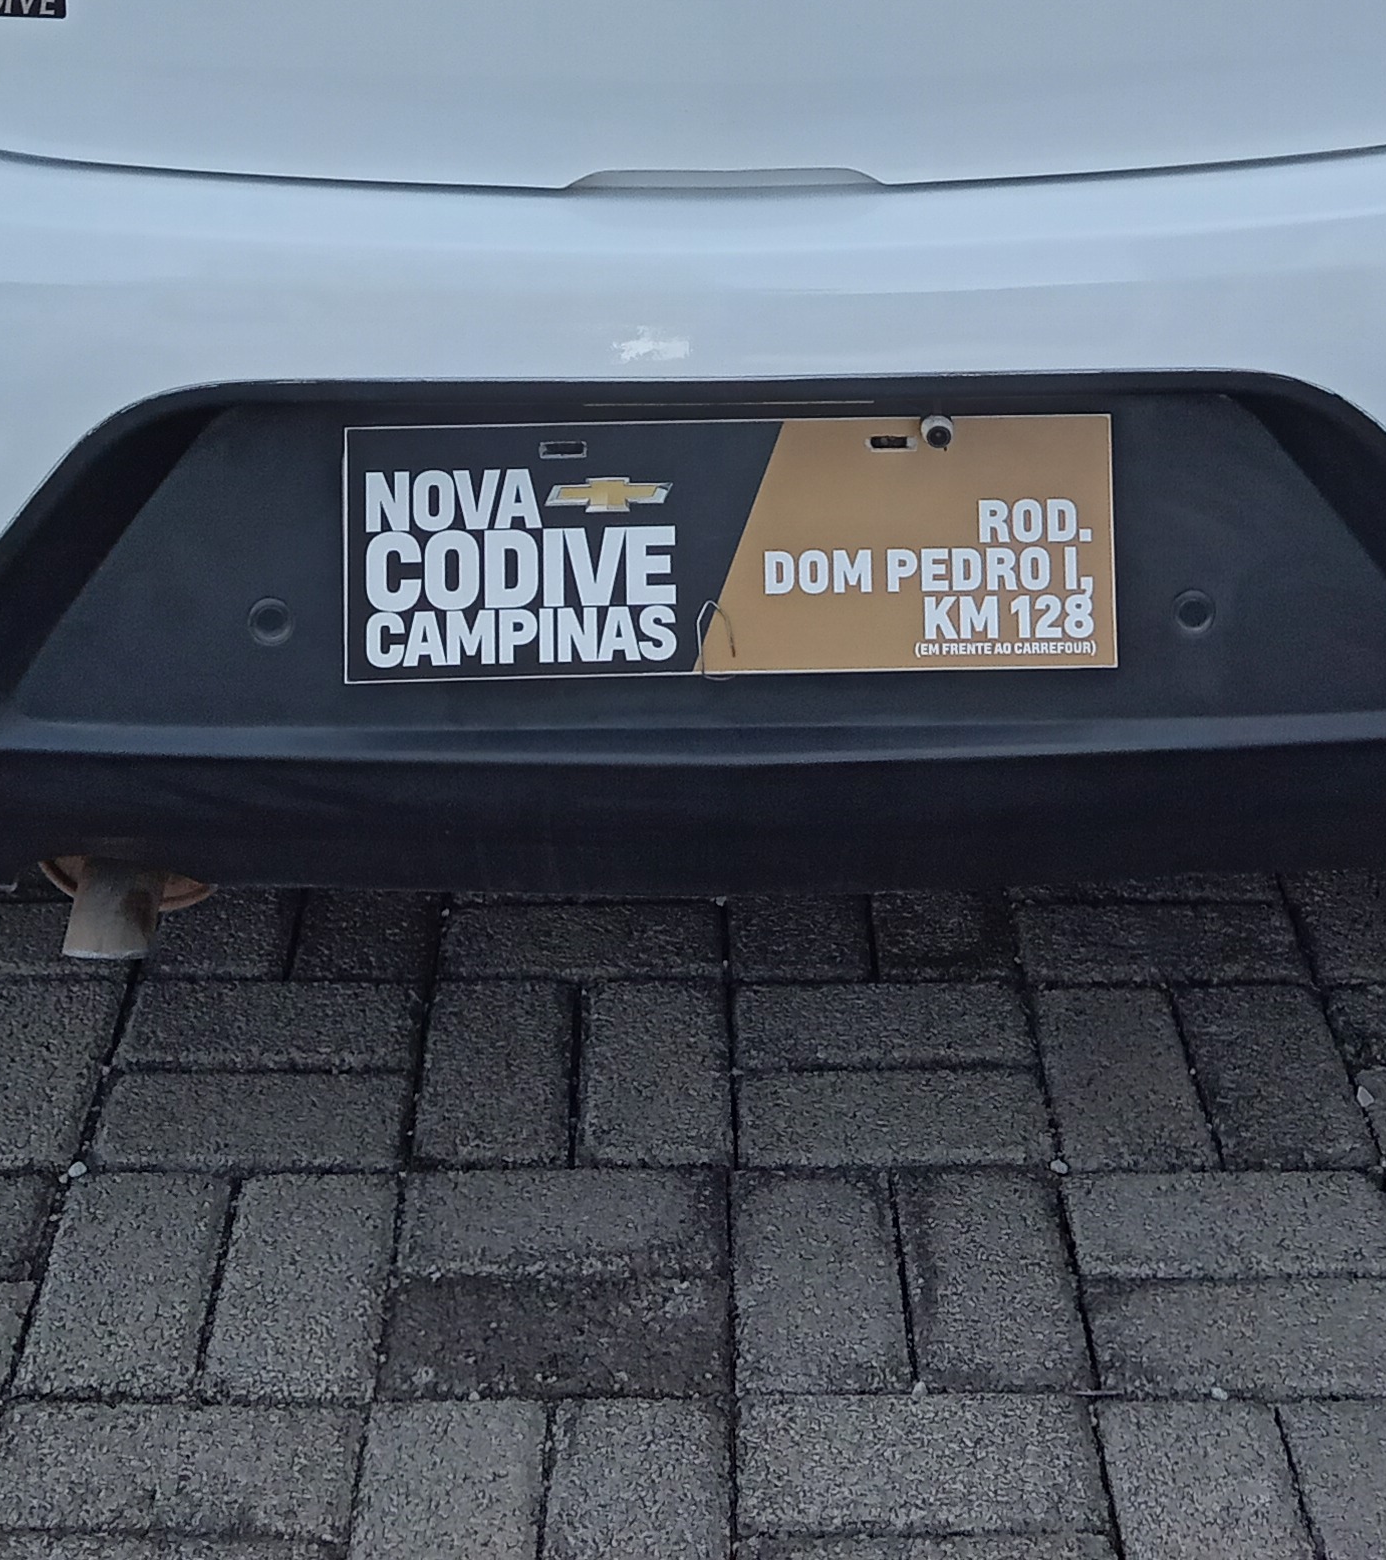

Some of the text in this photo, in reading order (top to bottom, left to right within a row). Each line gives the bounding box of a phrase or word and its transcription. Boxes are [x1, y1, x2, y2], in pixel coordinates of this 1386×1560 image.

[365, 469, 543, 533] NOVA
[978, 498, 1093, 543] ROD.
[366, 525, 677, 613] CODIVE
[764, 545, 1094, 598] DOM PEDRO I,
[366, 605, 678, 669] CAMPINAS
[924, 594, 1095, 639] KM 128
[914, 640, 1097, 658] (EM FRENTE AO CARREFOUR)
